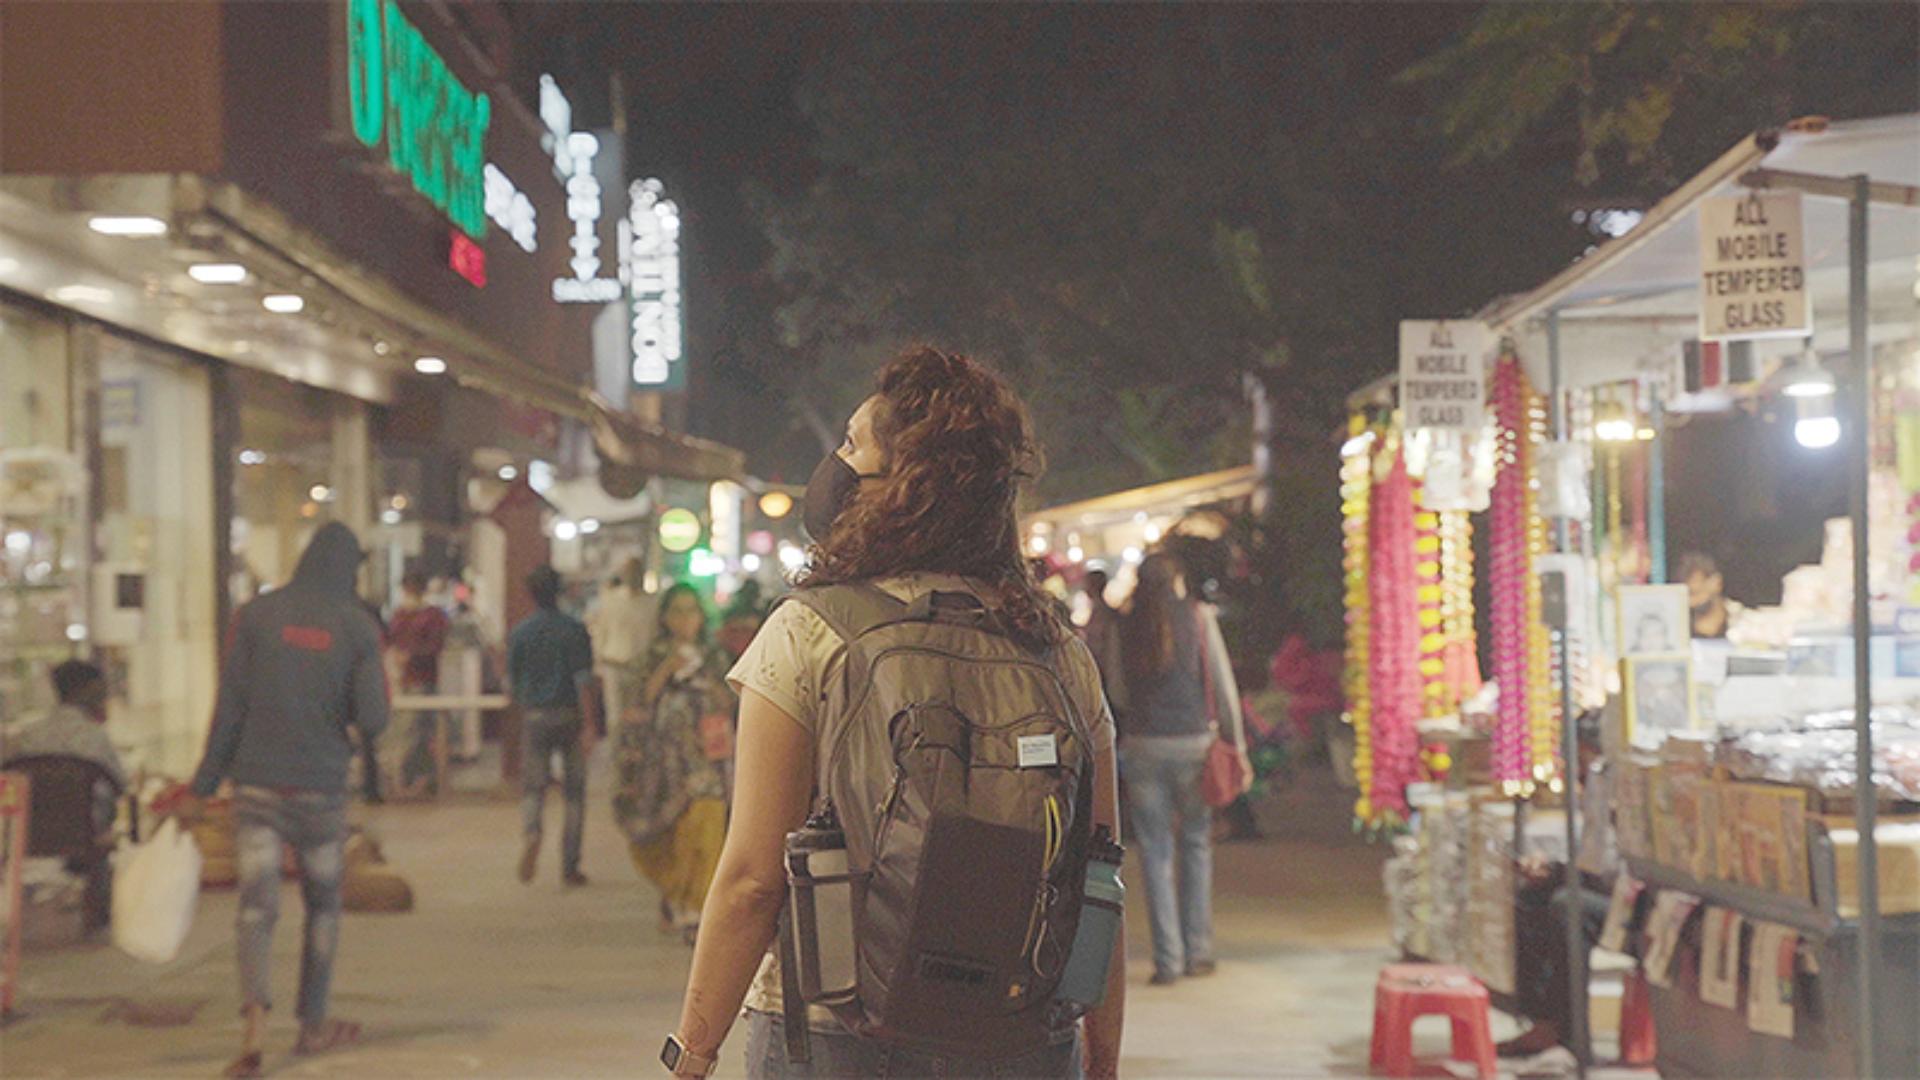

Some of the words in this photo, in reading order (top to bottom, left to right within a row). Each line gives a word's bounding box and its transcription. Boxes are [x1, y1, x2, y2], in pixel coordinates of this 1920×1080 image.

[1734, 200, 1767, 225] ALL
[1717, 232, 1787, 261] MOBILE
[1704, 266, 1804, 295] TEMPERED
[1725, 301, 1785, 328] GLASS
[1429, 328, 1454, 349] ALL
[1416, 354, 1467, 375] MOBILE
[1406, 380, 1478, 401] TEMPERED
[1418, 405, 1464, 427] GLASS
